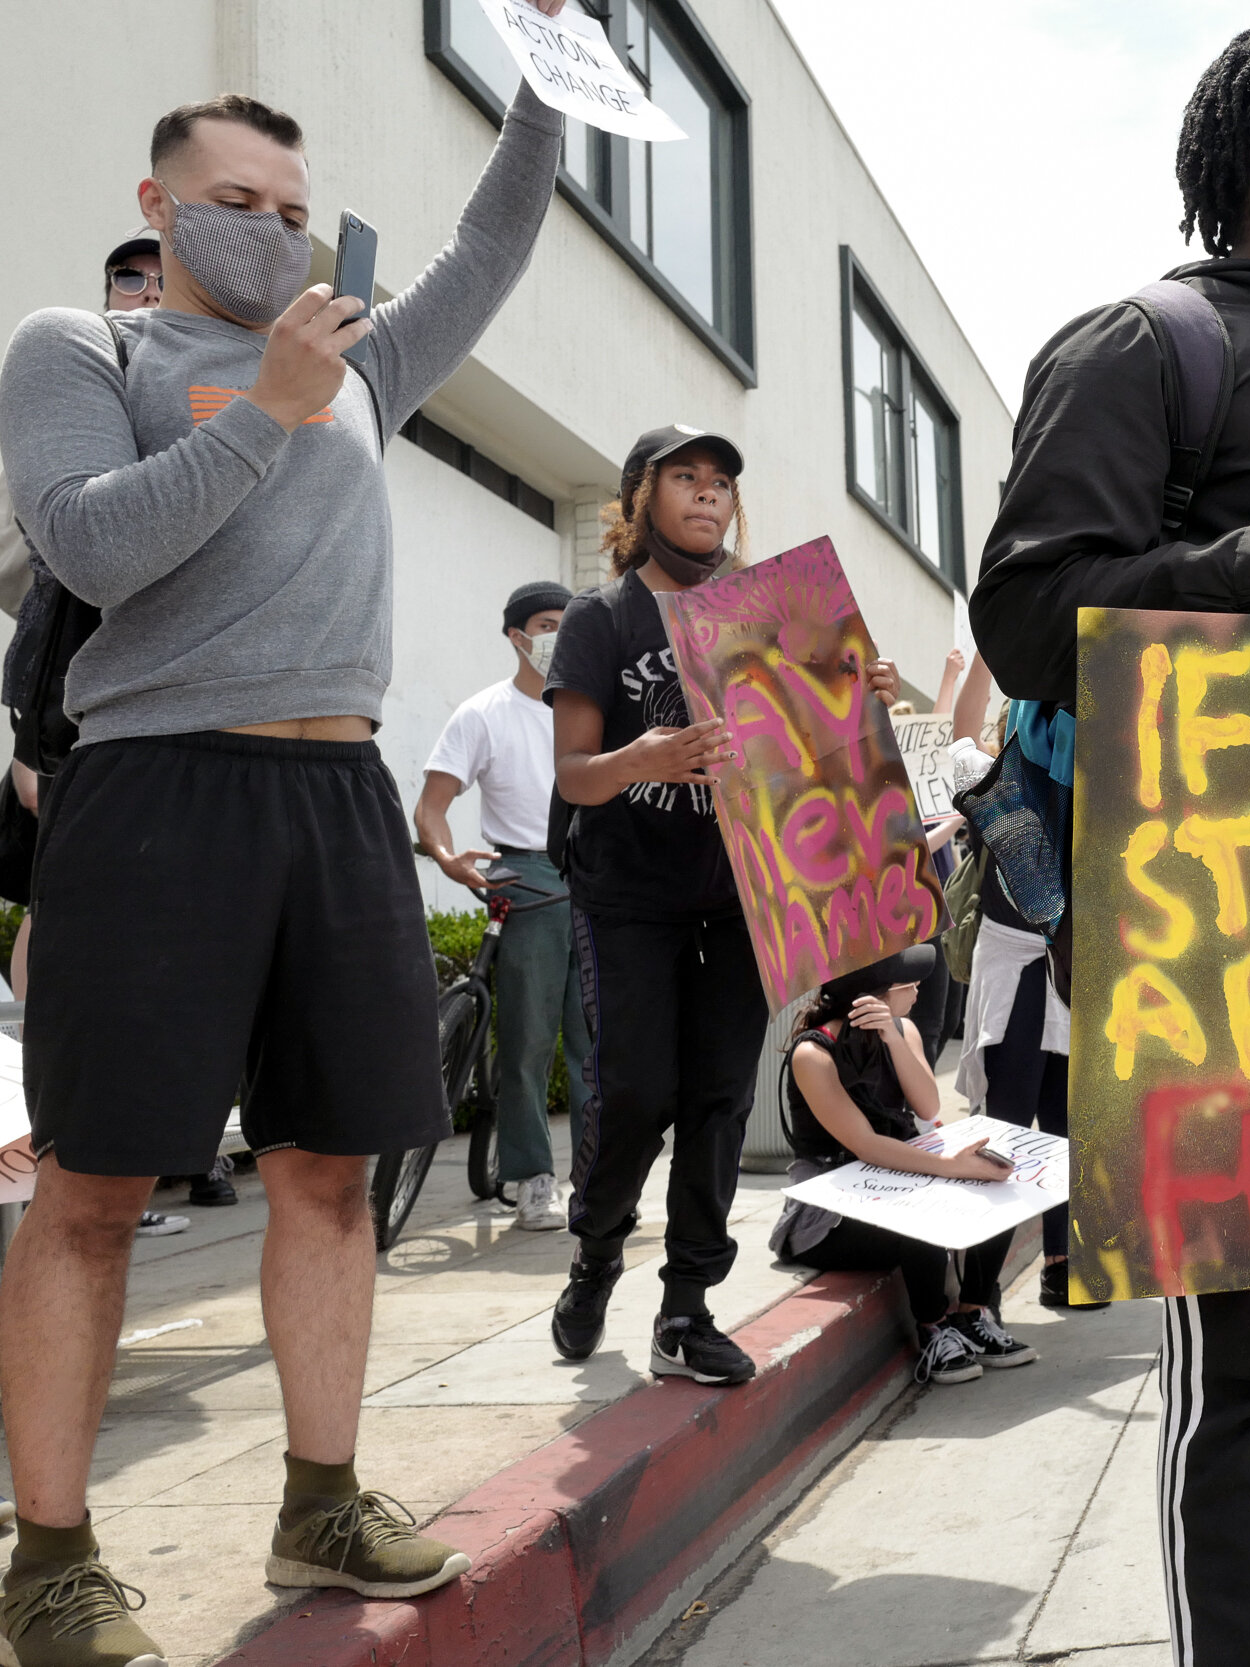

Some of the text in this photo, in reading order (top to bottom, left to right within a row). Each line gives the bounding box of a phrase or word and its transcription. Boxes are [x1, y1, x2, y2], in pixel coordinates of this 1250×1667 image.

[529, 52, 638, 116] CHANGE
[918, 750, 940, 776] IS
[1105, 963, 1206, 1081] A
[852, 1178, 915, 1194] Sworn
